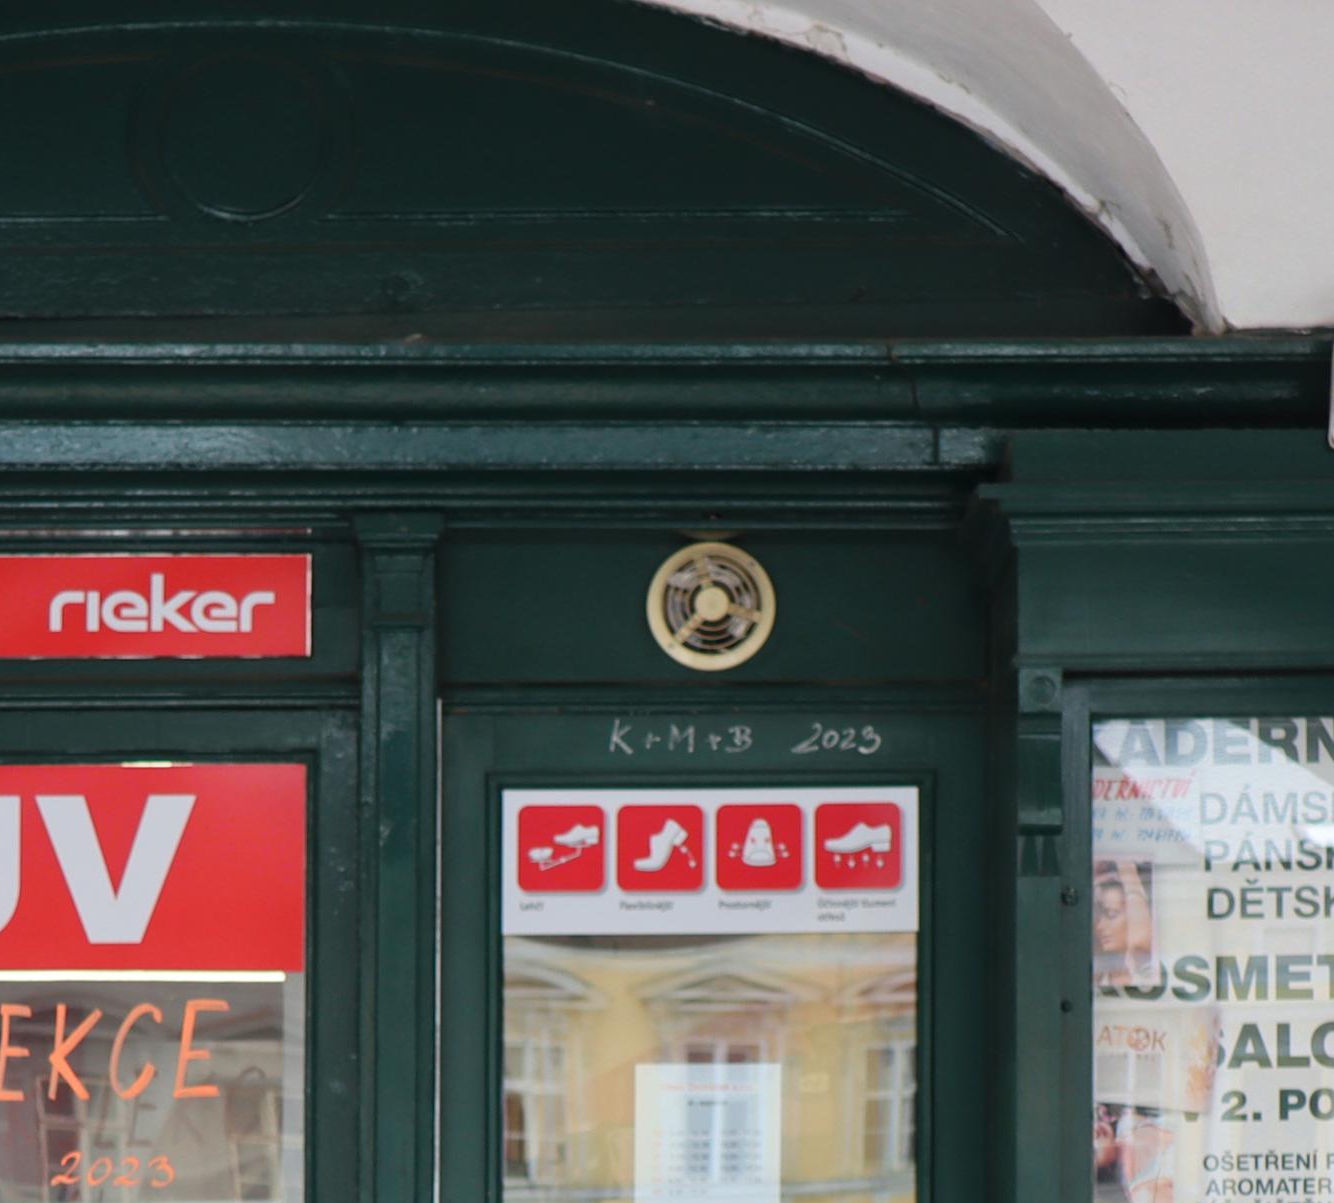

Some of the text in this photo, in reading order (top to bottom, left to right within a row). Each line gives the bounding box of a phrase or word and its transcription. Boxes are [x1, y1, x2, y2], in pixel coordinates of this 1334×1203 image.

[49, 573, 275, 633] rieker
[791, 722, 882, 755] 2023
[1220, 1090, 1263, 1122] 2.
[50, 1151, 176, 1188] 2023
[1203, 1151, 1318, 1172] OŠETŘENÍ
